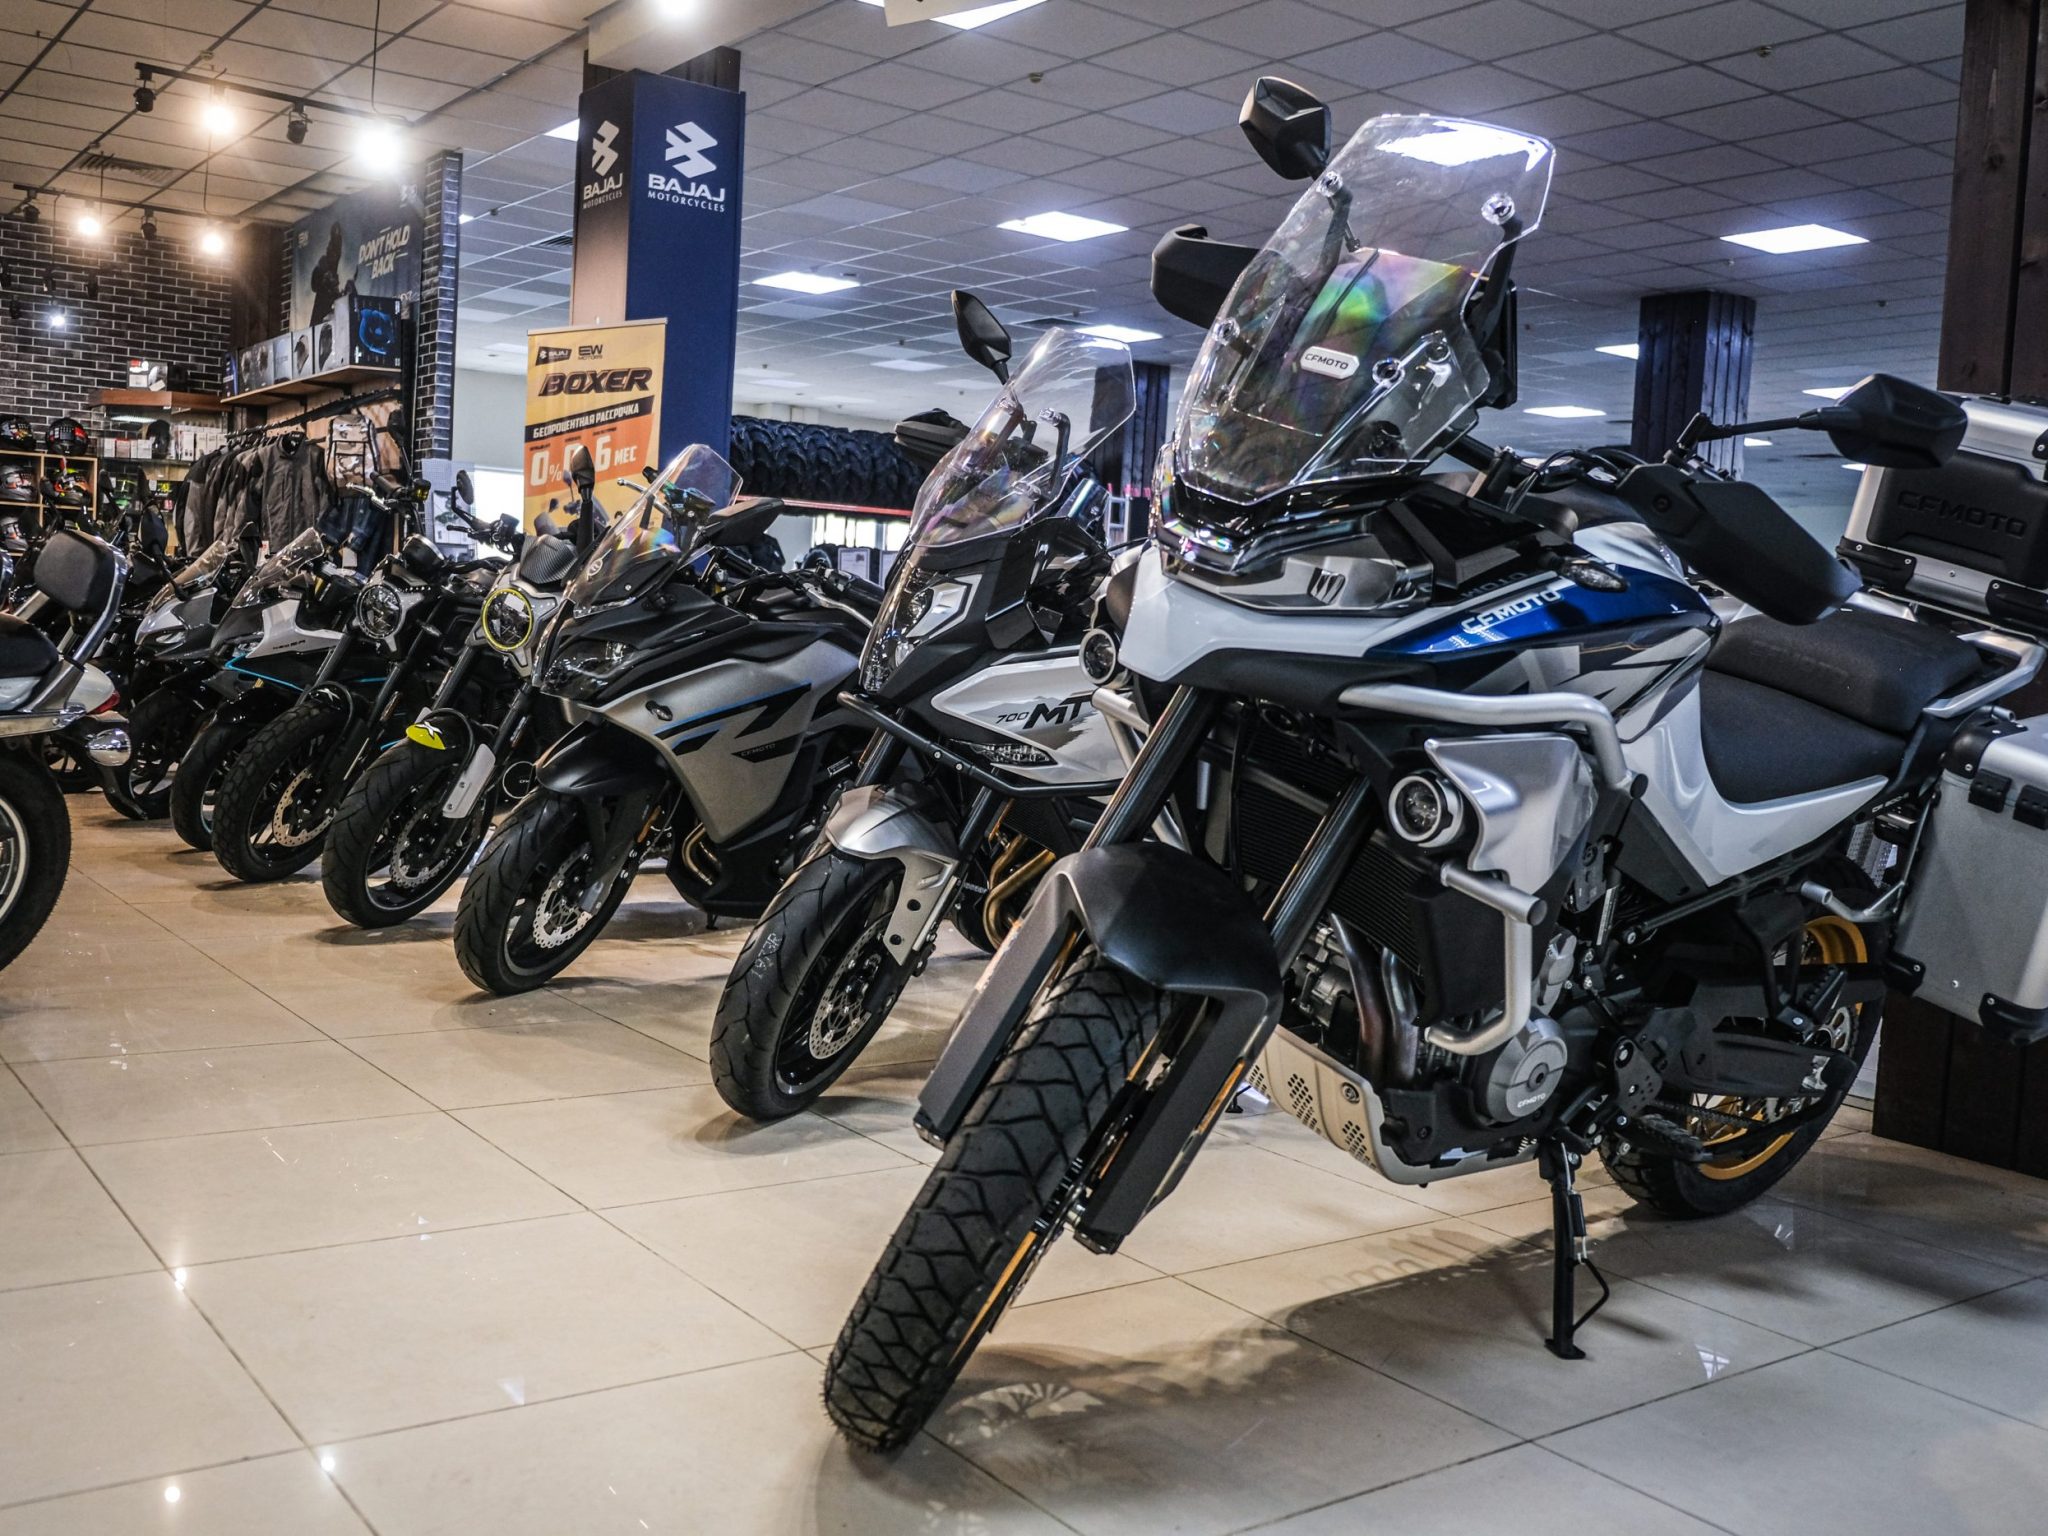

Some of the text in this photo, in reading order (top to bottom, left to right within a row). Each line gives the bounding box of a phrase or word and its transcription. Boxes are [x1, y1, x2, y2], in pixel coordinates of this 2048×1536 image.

[583, 173, 623, 200] BAJAJ
[583, 190, 623, 209] MOTORCYCLES
[648, 173, 725, 202] BAJAJ
[648, 190, 725, 213] MOTORCYCLES
[384, 225, 410, 253] HOLD
[371, 252, 396, 279] BACK
[1304, 353, 1349, 370] CFMOTO
[538, 366, 653, 397] BOXER
[533, 403, 640, 439] БЕСПРОЦЕНТНАЯ РАССРОЧКА
[594, 434, 612, 472] 6
[1897, 490, 2027, 540] CFMOTO
[1461, 589, 1562, 633] CFMOTO
